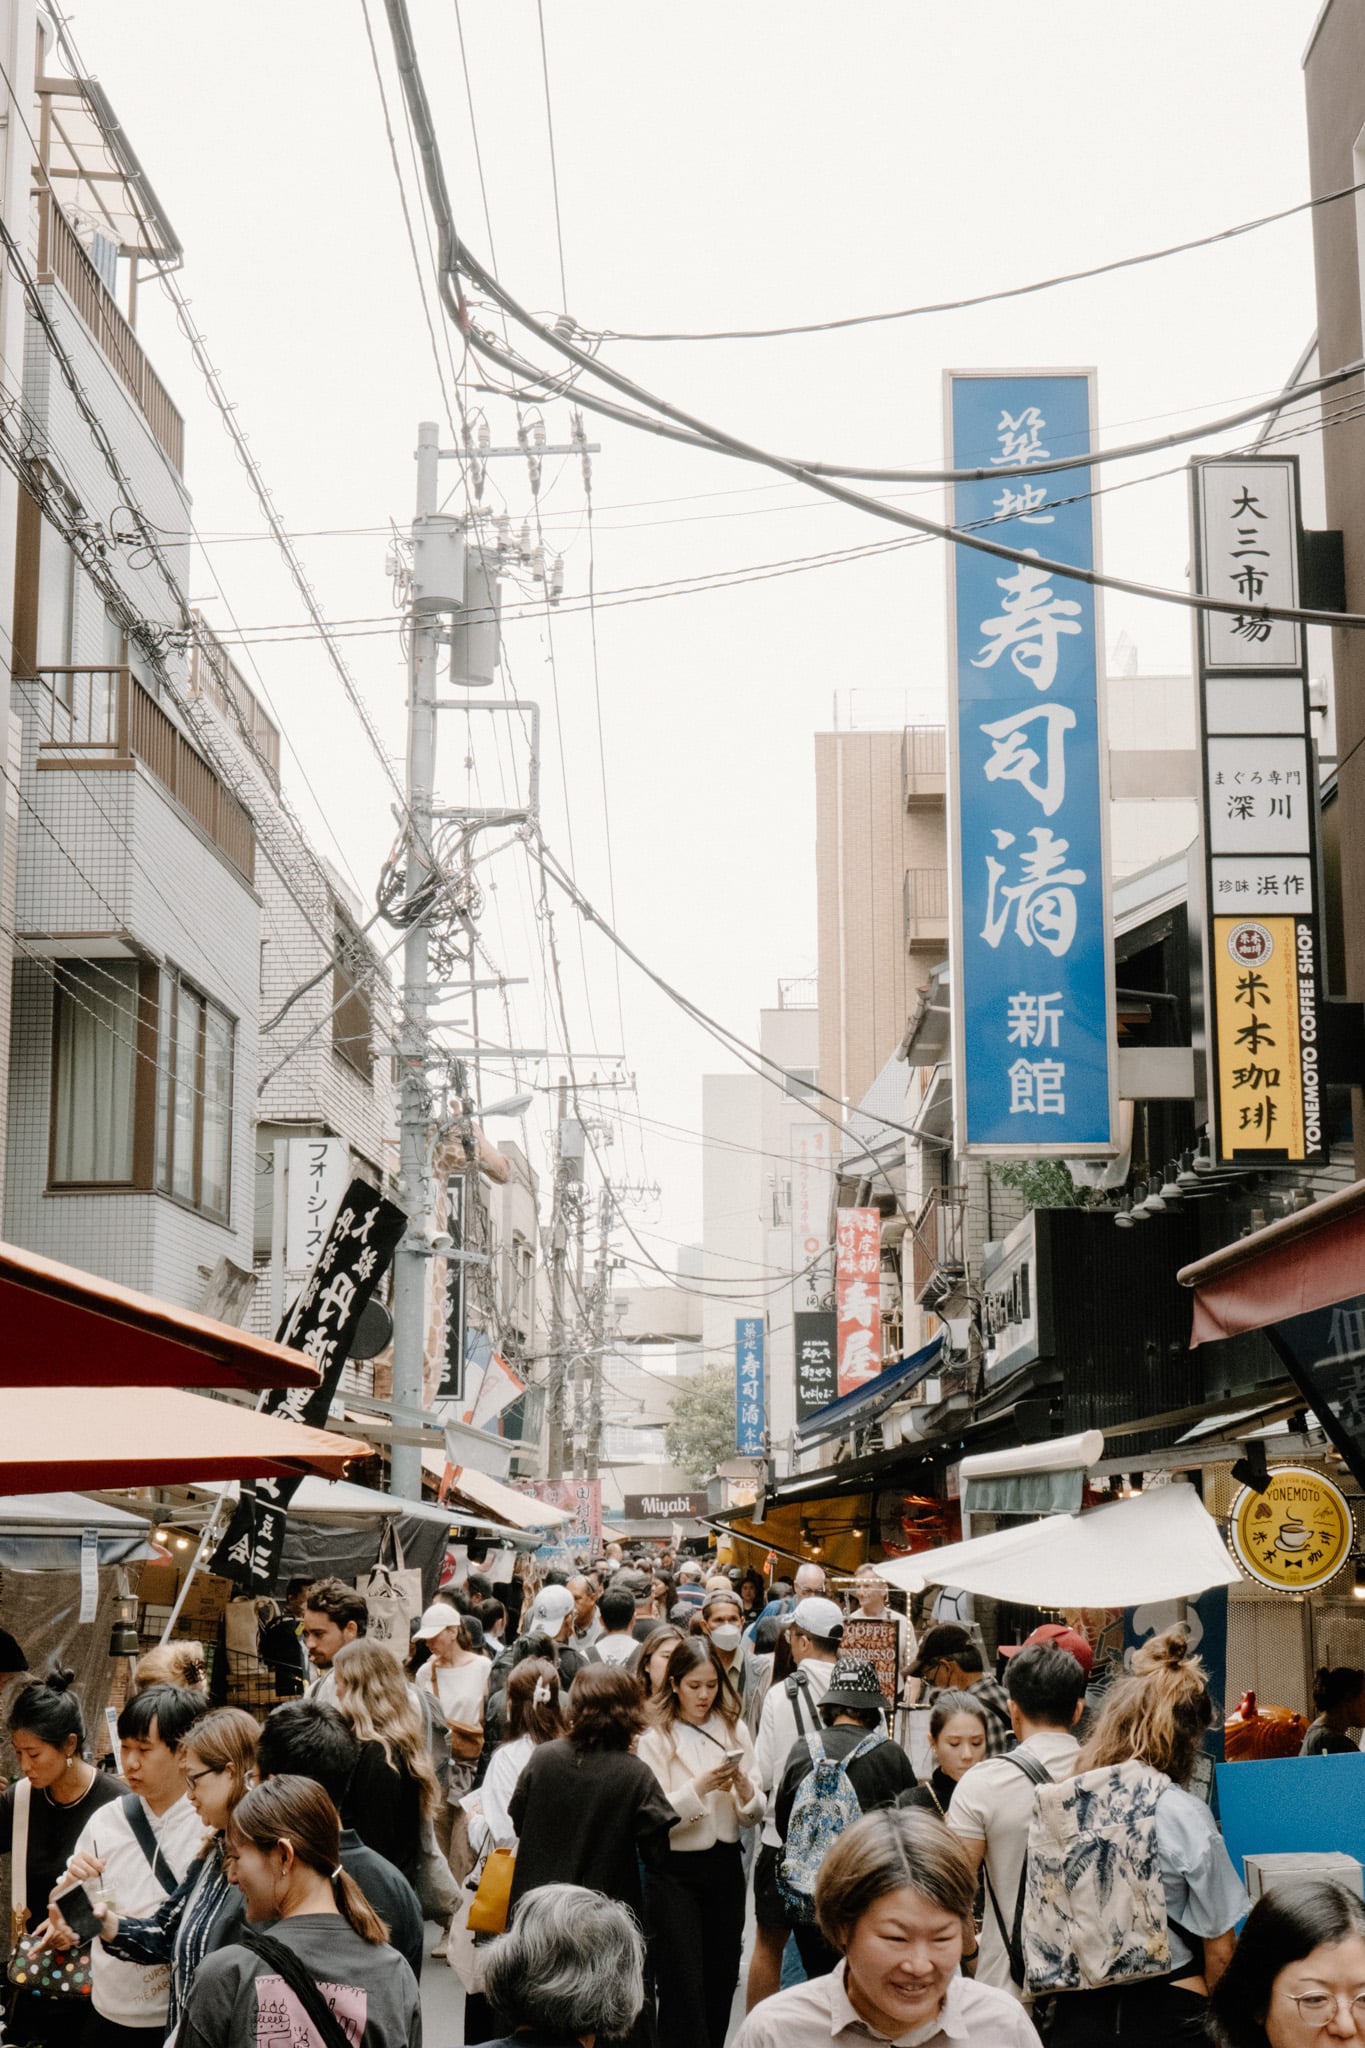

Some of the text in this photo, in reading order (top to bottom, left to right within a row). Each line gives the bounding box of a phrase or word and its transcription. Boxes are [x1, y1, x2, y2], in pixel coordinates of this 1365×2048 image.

[1229, 486, 1274, 643] 大三市場
[970, 548, 1086, 957] 寿司清
[1215, 770, 1301, 785] まぐろ専門
[1227, 794, 1292, 820] 深川
[1218, 874, 1305, 895] 珍味 浜作
[1006, 991, 1065, 1115] 新館
[1232, 970, 1281, 1142] 米本珈琲
[1297, 923, 1322, 1154] YONEMOTO COFFEE SHOP
[839, 1276, 881, 1378] 寿屋
[741, 1351, 760, 1425] 寿司清
[1266, 1486, 1320, 1502] YONEMOTO
[877, 1671, 895, 1683] RIP
